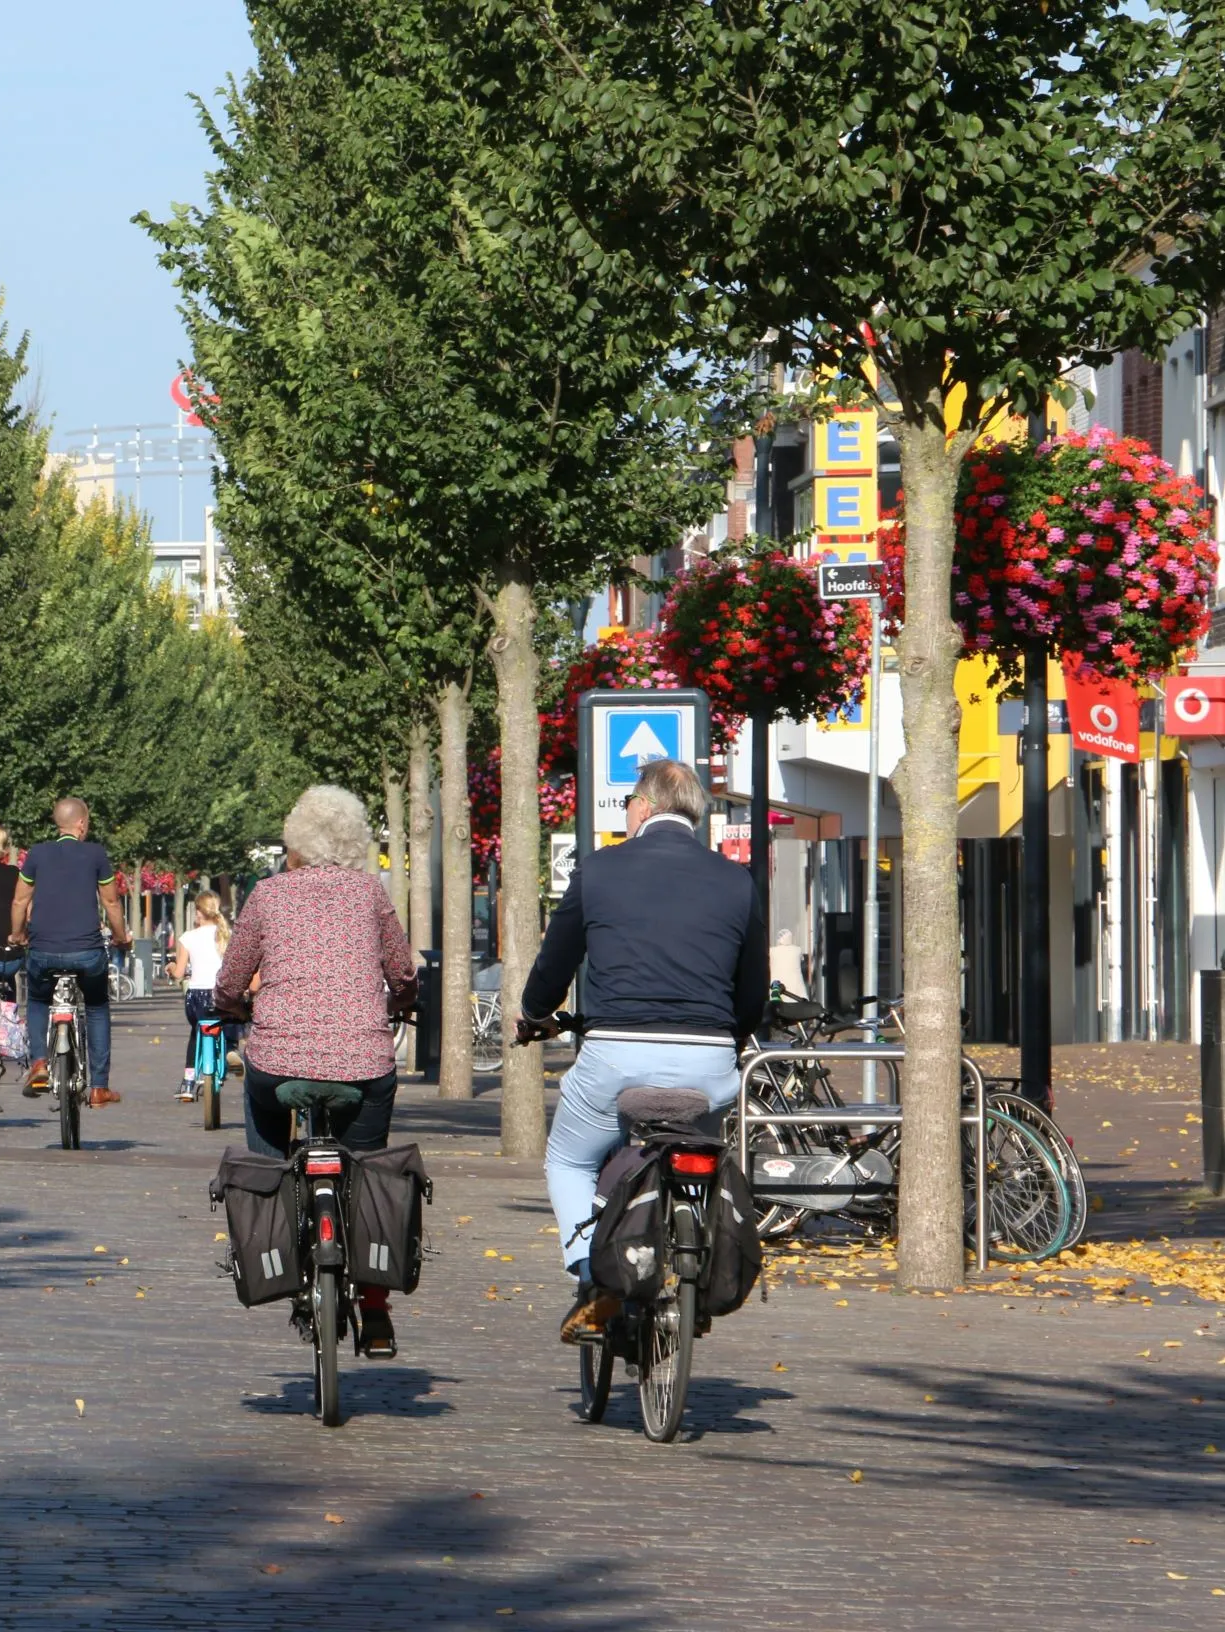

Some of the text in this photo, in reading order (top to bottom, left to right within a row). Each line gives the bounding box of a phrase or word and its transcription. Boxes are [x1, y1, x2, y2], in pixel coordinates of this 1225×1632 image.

[69, 437, 213, 467] SCHEE
[1078, 730, 1135, 754] vodafone
[598, 797, 626, 811] uitg
